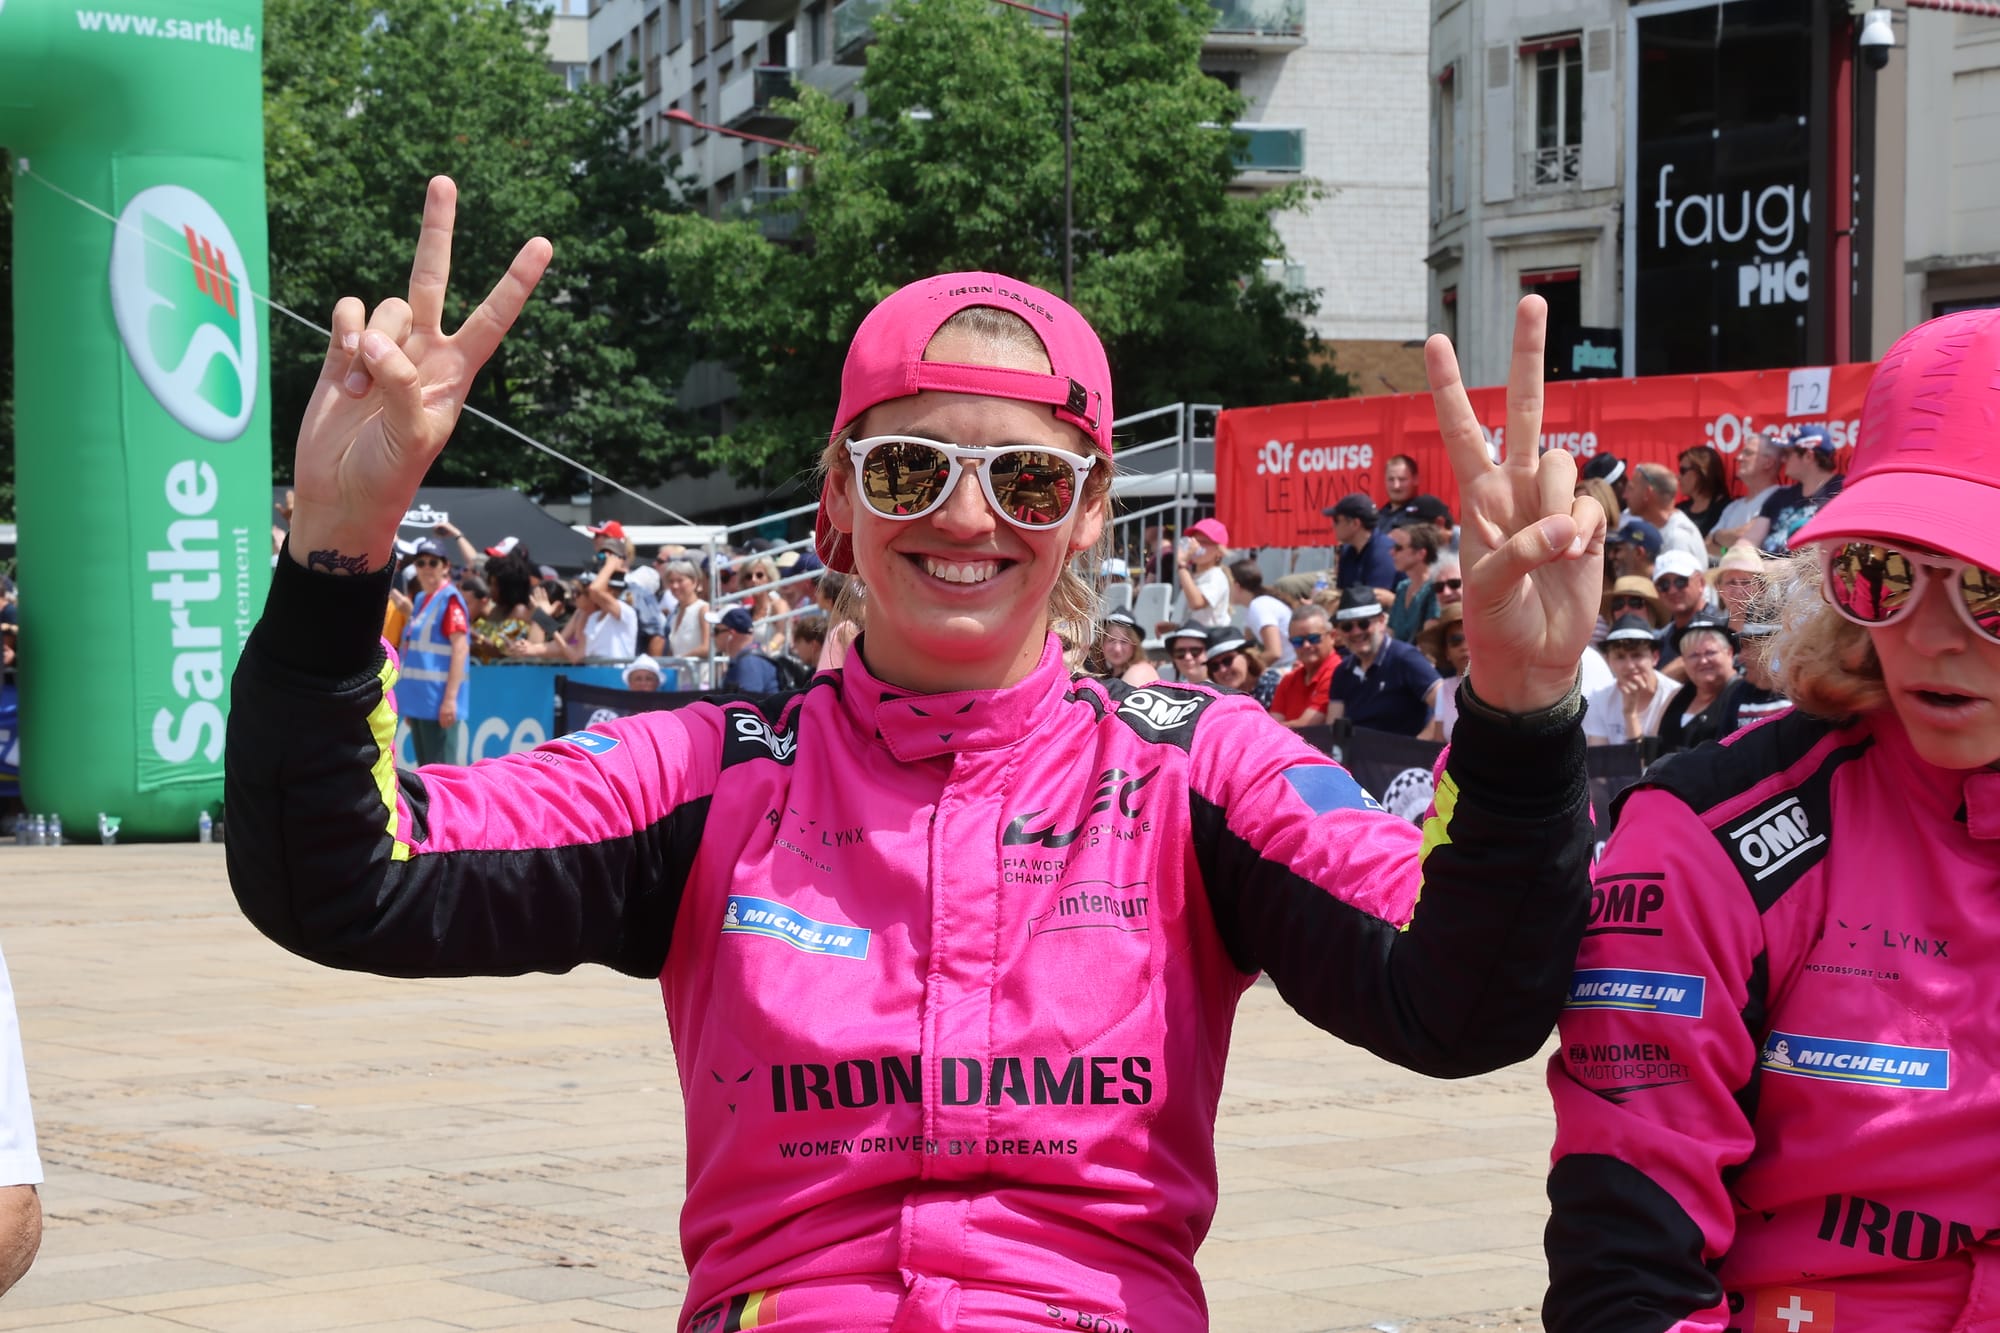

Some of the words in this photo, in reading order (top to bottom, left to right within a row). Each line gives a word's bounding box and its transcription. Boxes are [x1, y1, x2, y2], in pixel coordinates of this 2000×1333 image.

[76, 10, 256, 52] www.sarthe.fr
[1655, 164, 1810, 255] faug
[949, 286, 993, 297] IRON
[998, 287, 1053, 323] DAMES
[1791, 384, 1804, 412] T
[1808, 382, 1821, 410] 2
[1297, 444, 1373, 473] course
[1265, 478, 1293, 514] LE
[147, 459, 226, 764] Sarthe
[1123, 692, 1198, 726] OMP
[822, 827, 864, 847] LYNX
[1740, 806, 1810, 867] OMP
[1003, 858, 1028, 870] FIA
[743, 909, 853, 947] MICHELIN
[1883, 930, 1948, 958] LYNX
[1805, 963, 1873, 978] MOTORSPORT
[1878, 971, 1900, 980] LAB
[1575, 982, 1686, 1002] MICHELIN
[1591, 1043, 1670, 1062] WOMEN
[1797, 1050, 1930, 1076] MICHELIN
[771, 1055, 922, 1113] IRON
[941, 1056, 1153, 1106] DAMES
[1584, 1063, 1690, 1080] MOTORSPORT
[779, 1139, 854, 1158] WOMEN
[861, 1136, 938, 1155] DRIVEN
[949, 1140, 977, 1155] BY
[986, 1139, 1078, 1155] DREAMS
